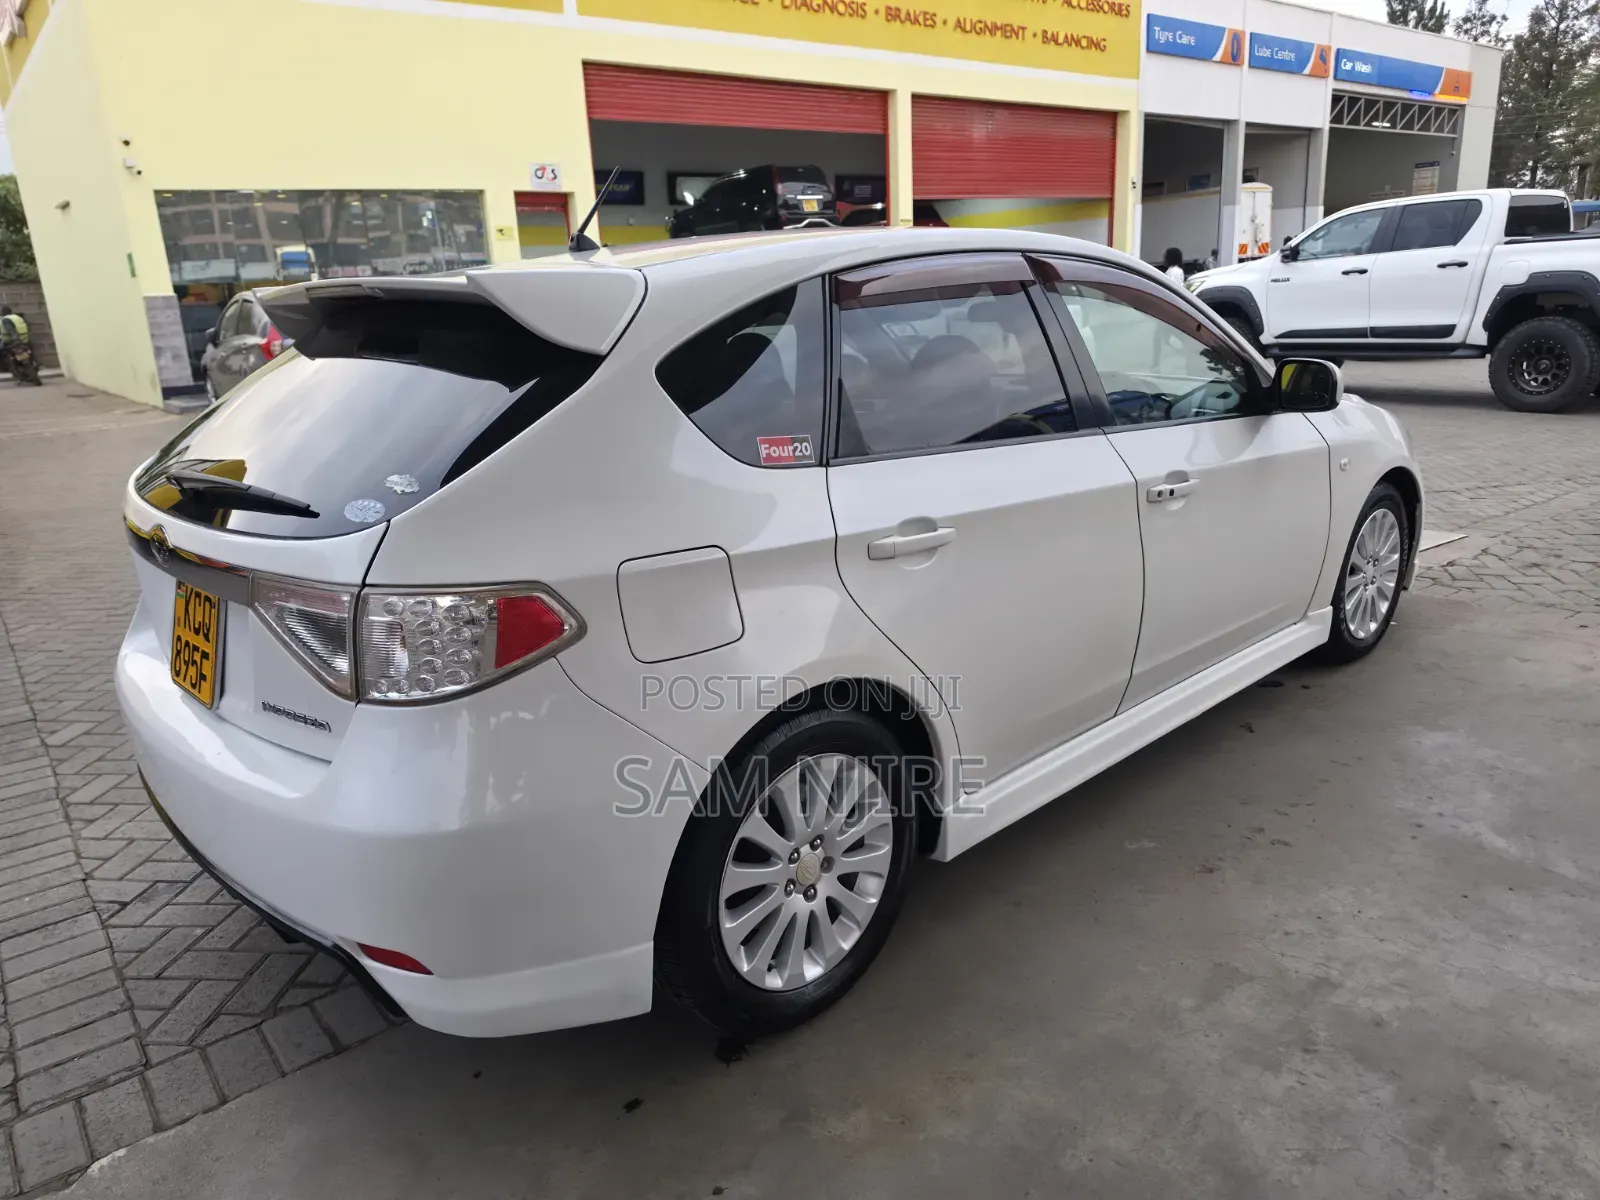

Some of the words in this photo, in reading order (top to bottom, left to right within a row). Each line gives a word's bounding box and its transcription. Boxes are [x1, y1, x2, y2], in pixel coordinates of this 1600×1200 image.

[781, 0, 868, 19] DIAGNOSIS
[884, 5, 937, 29] BRAKES
[953, 16, 1028, 41] ALIGNMENT
[1041, 29, 1107, 52] BALANCING
[1153, 26, 1174, 43] Tyre
[1176, 31, 1196, 46] Care
[1254, 44, 1272, 58] Lube
[1273, 47, 1296, 62] Centre
[1341, 59, 1353, 71] Car
[1354, 61, 1373, 73] Wash
[760, 442, 811, 458] Four20
[184, 584, 212, 644] KCQ
[174, 634, 210, 694] 895F
